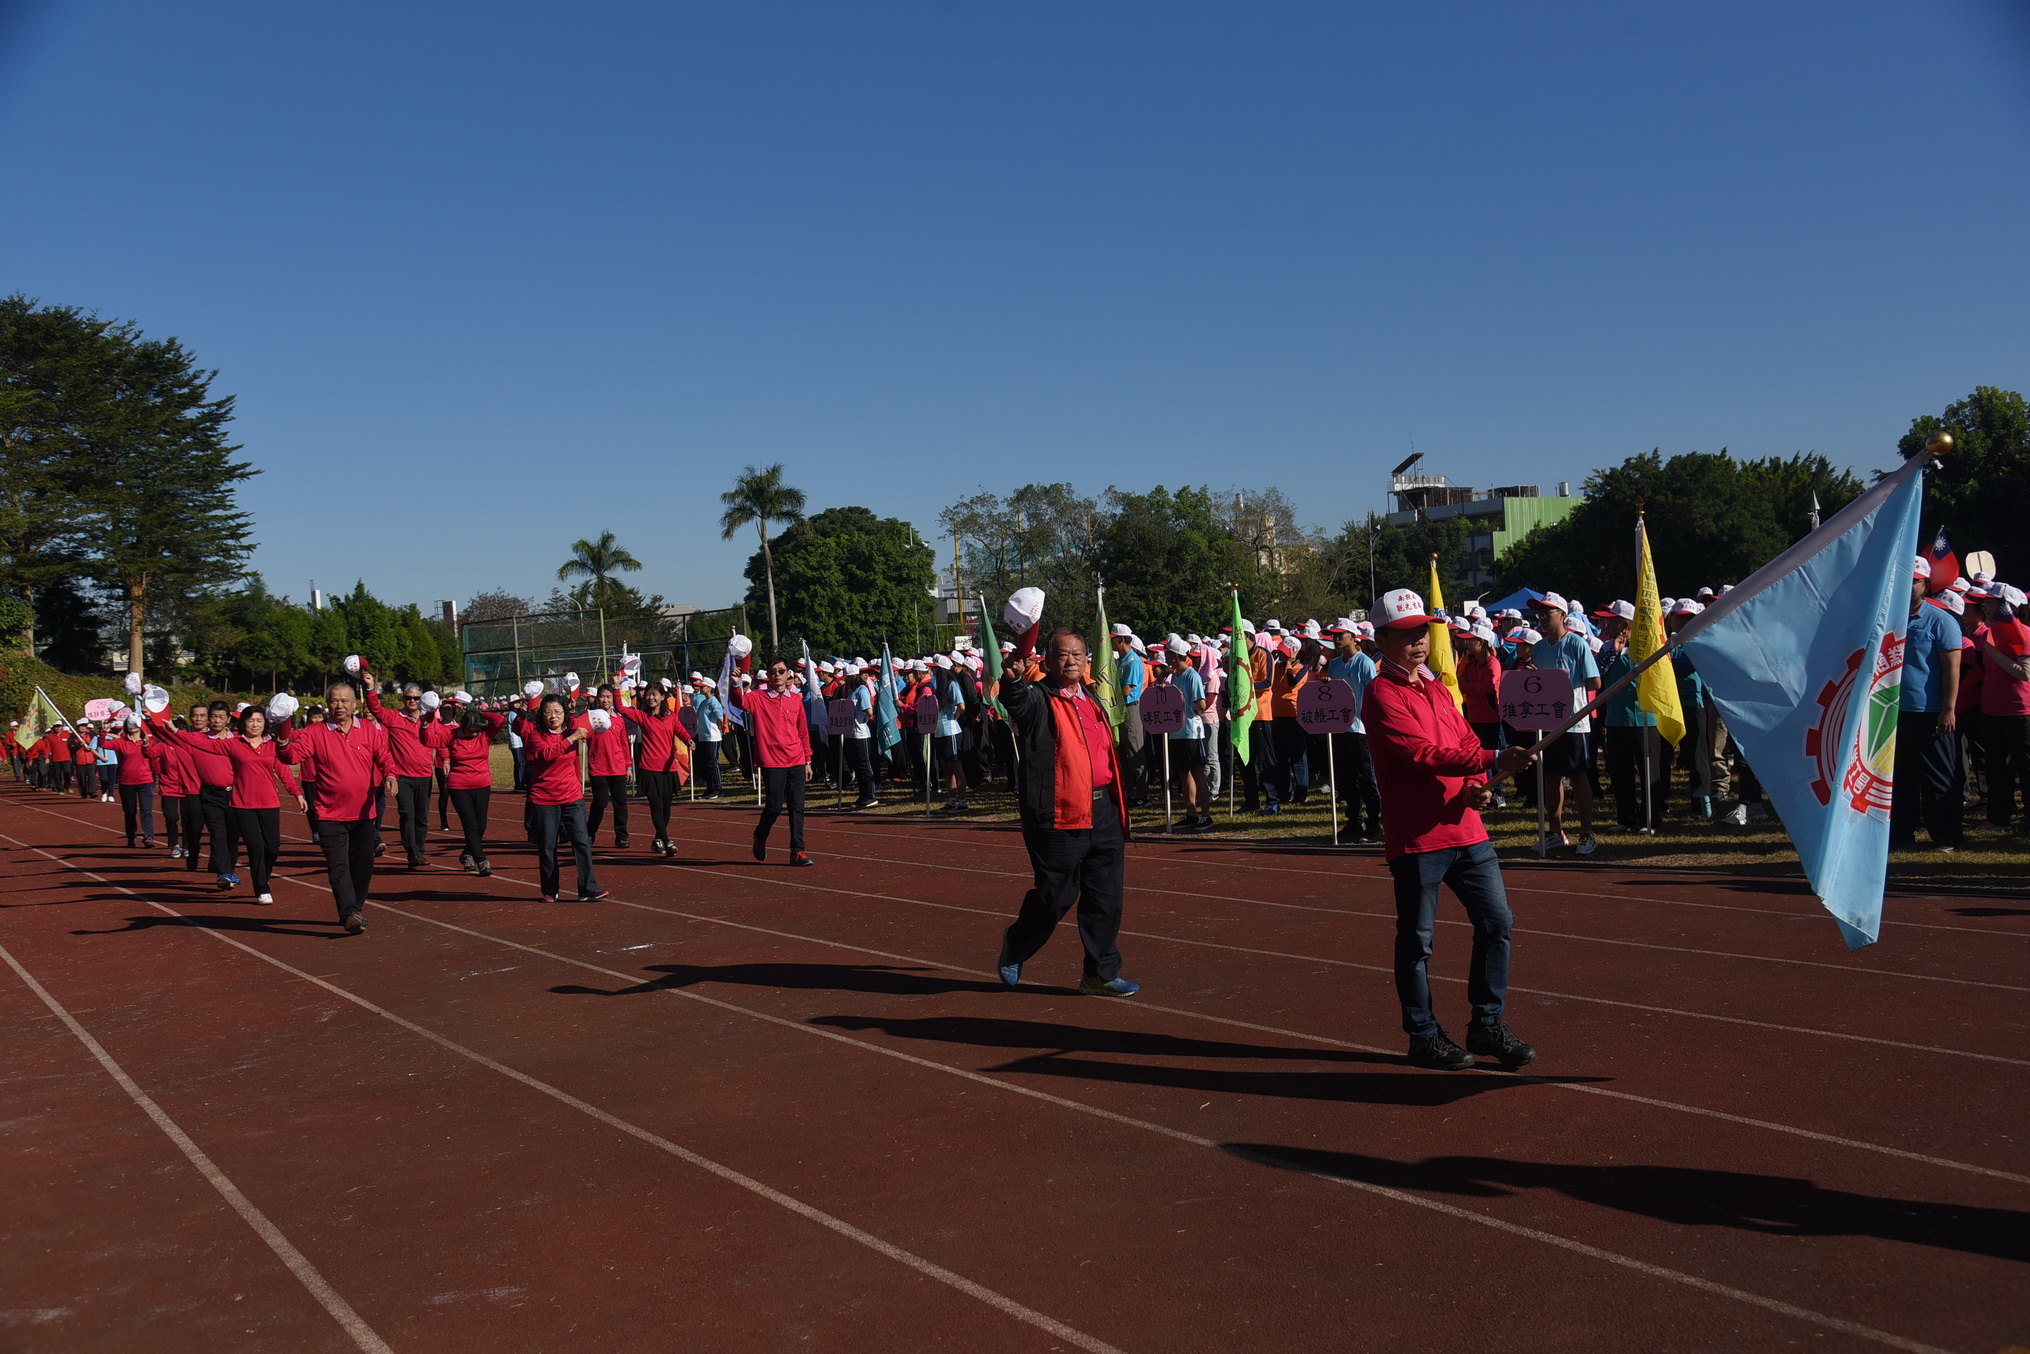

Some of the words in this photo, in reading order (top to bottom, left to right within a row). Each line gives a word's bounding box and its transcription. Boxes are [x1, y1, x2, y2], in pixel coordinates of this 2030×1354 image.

[1524, 675, 1542, 694] 6
[1155, 689, 1167, 705] 10
[1318, 686, 1333, 702] 8
[96, 701, 107, 709] 29
[837, 701, 846, 713] 16
[1502, 700, 1567, 719] 推拿工會
[1142, 708, 1182, 725] 磚瓦工會
[1301, 706, 1352, 724] 被帳工會
